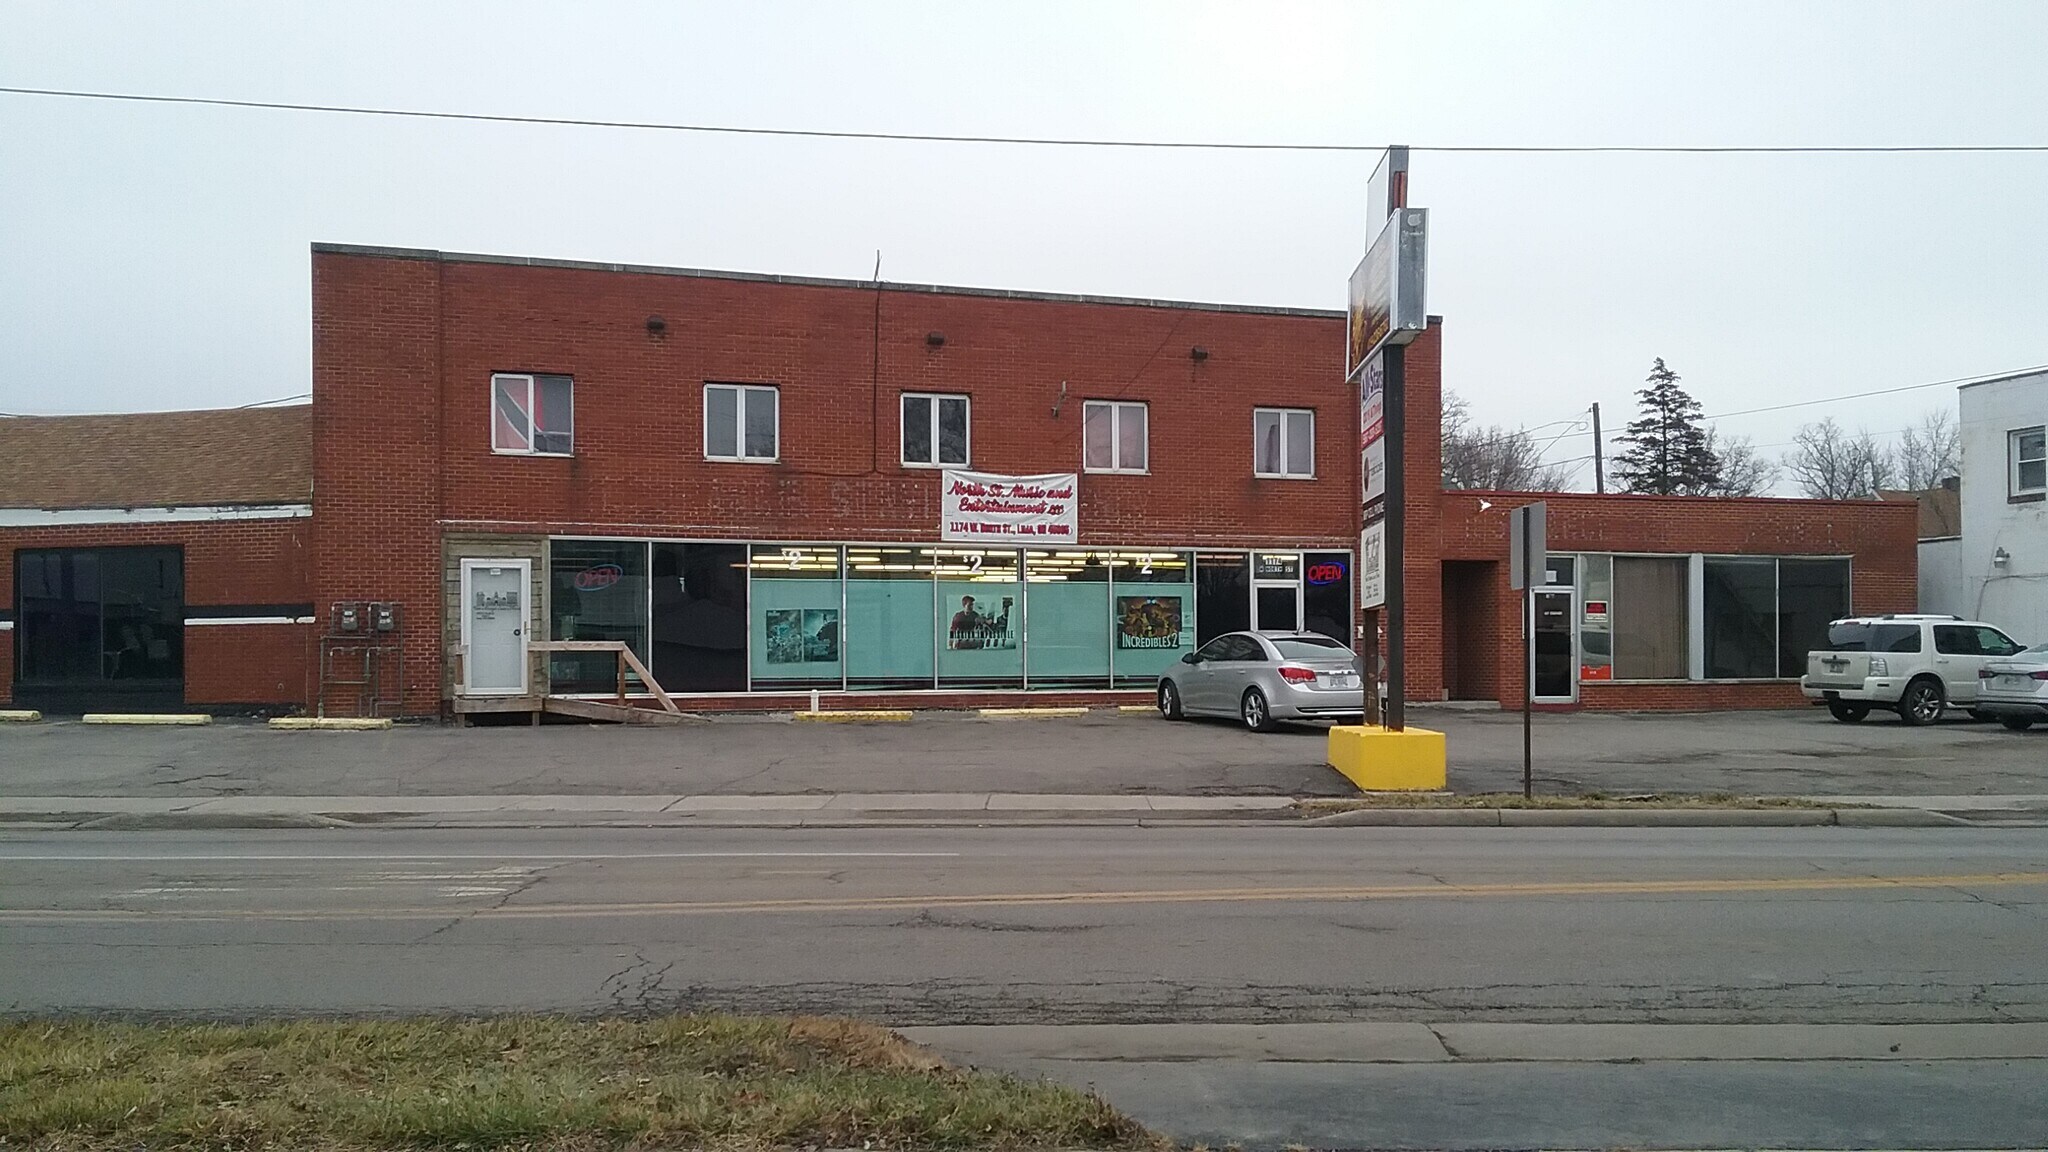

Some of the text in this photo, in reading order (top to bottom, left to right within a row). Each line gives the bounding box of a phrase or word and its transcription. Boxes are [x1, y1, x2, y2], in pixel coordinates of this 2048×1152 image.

[947, 480, 1073, 499] North St. Music and
[958, 497, 1048, 514] Entertainment
[950, 522, 968, 533] 1174
[576, 568, 618, 587] OPEN
[1308, 565, 1342, 581] OPEN
[1122, 631, 1178, 648] INCREDIBLES 2
